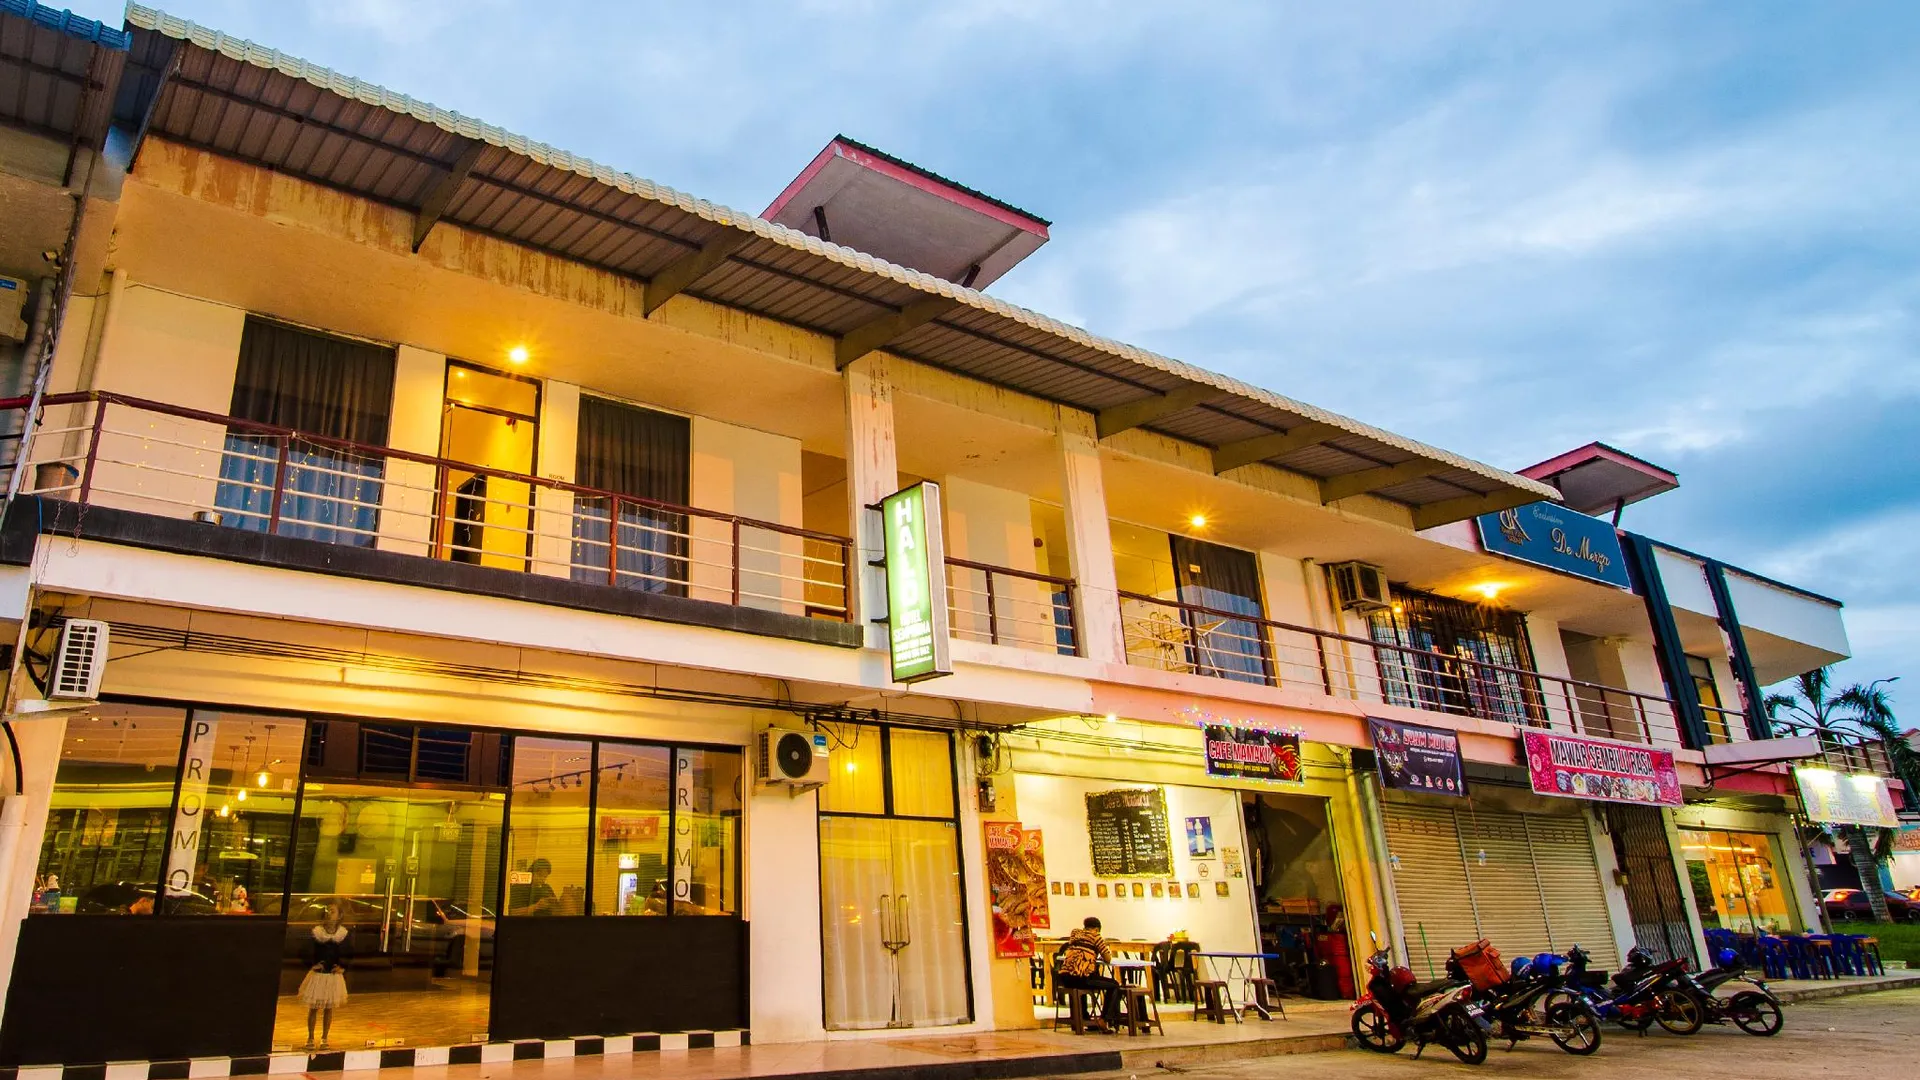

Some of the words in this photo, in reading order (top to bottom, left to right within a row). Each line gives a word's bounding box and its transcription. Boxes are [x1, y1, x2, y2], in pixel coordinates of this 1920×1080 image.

[1551, 528, 1573, 555] De
[1208, 740, 1232, 761] CAFE
[1549, 738, 1591, 768] MAWAR
[1588, 745, 1632, 774] SEMBILU
[1630, 750, 1655, 778] RASA
[168, 722, 210, 892] PROMO
[674, 758, 691, 898] PROMO
